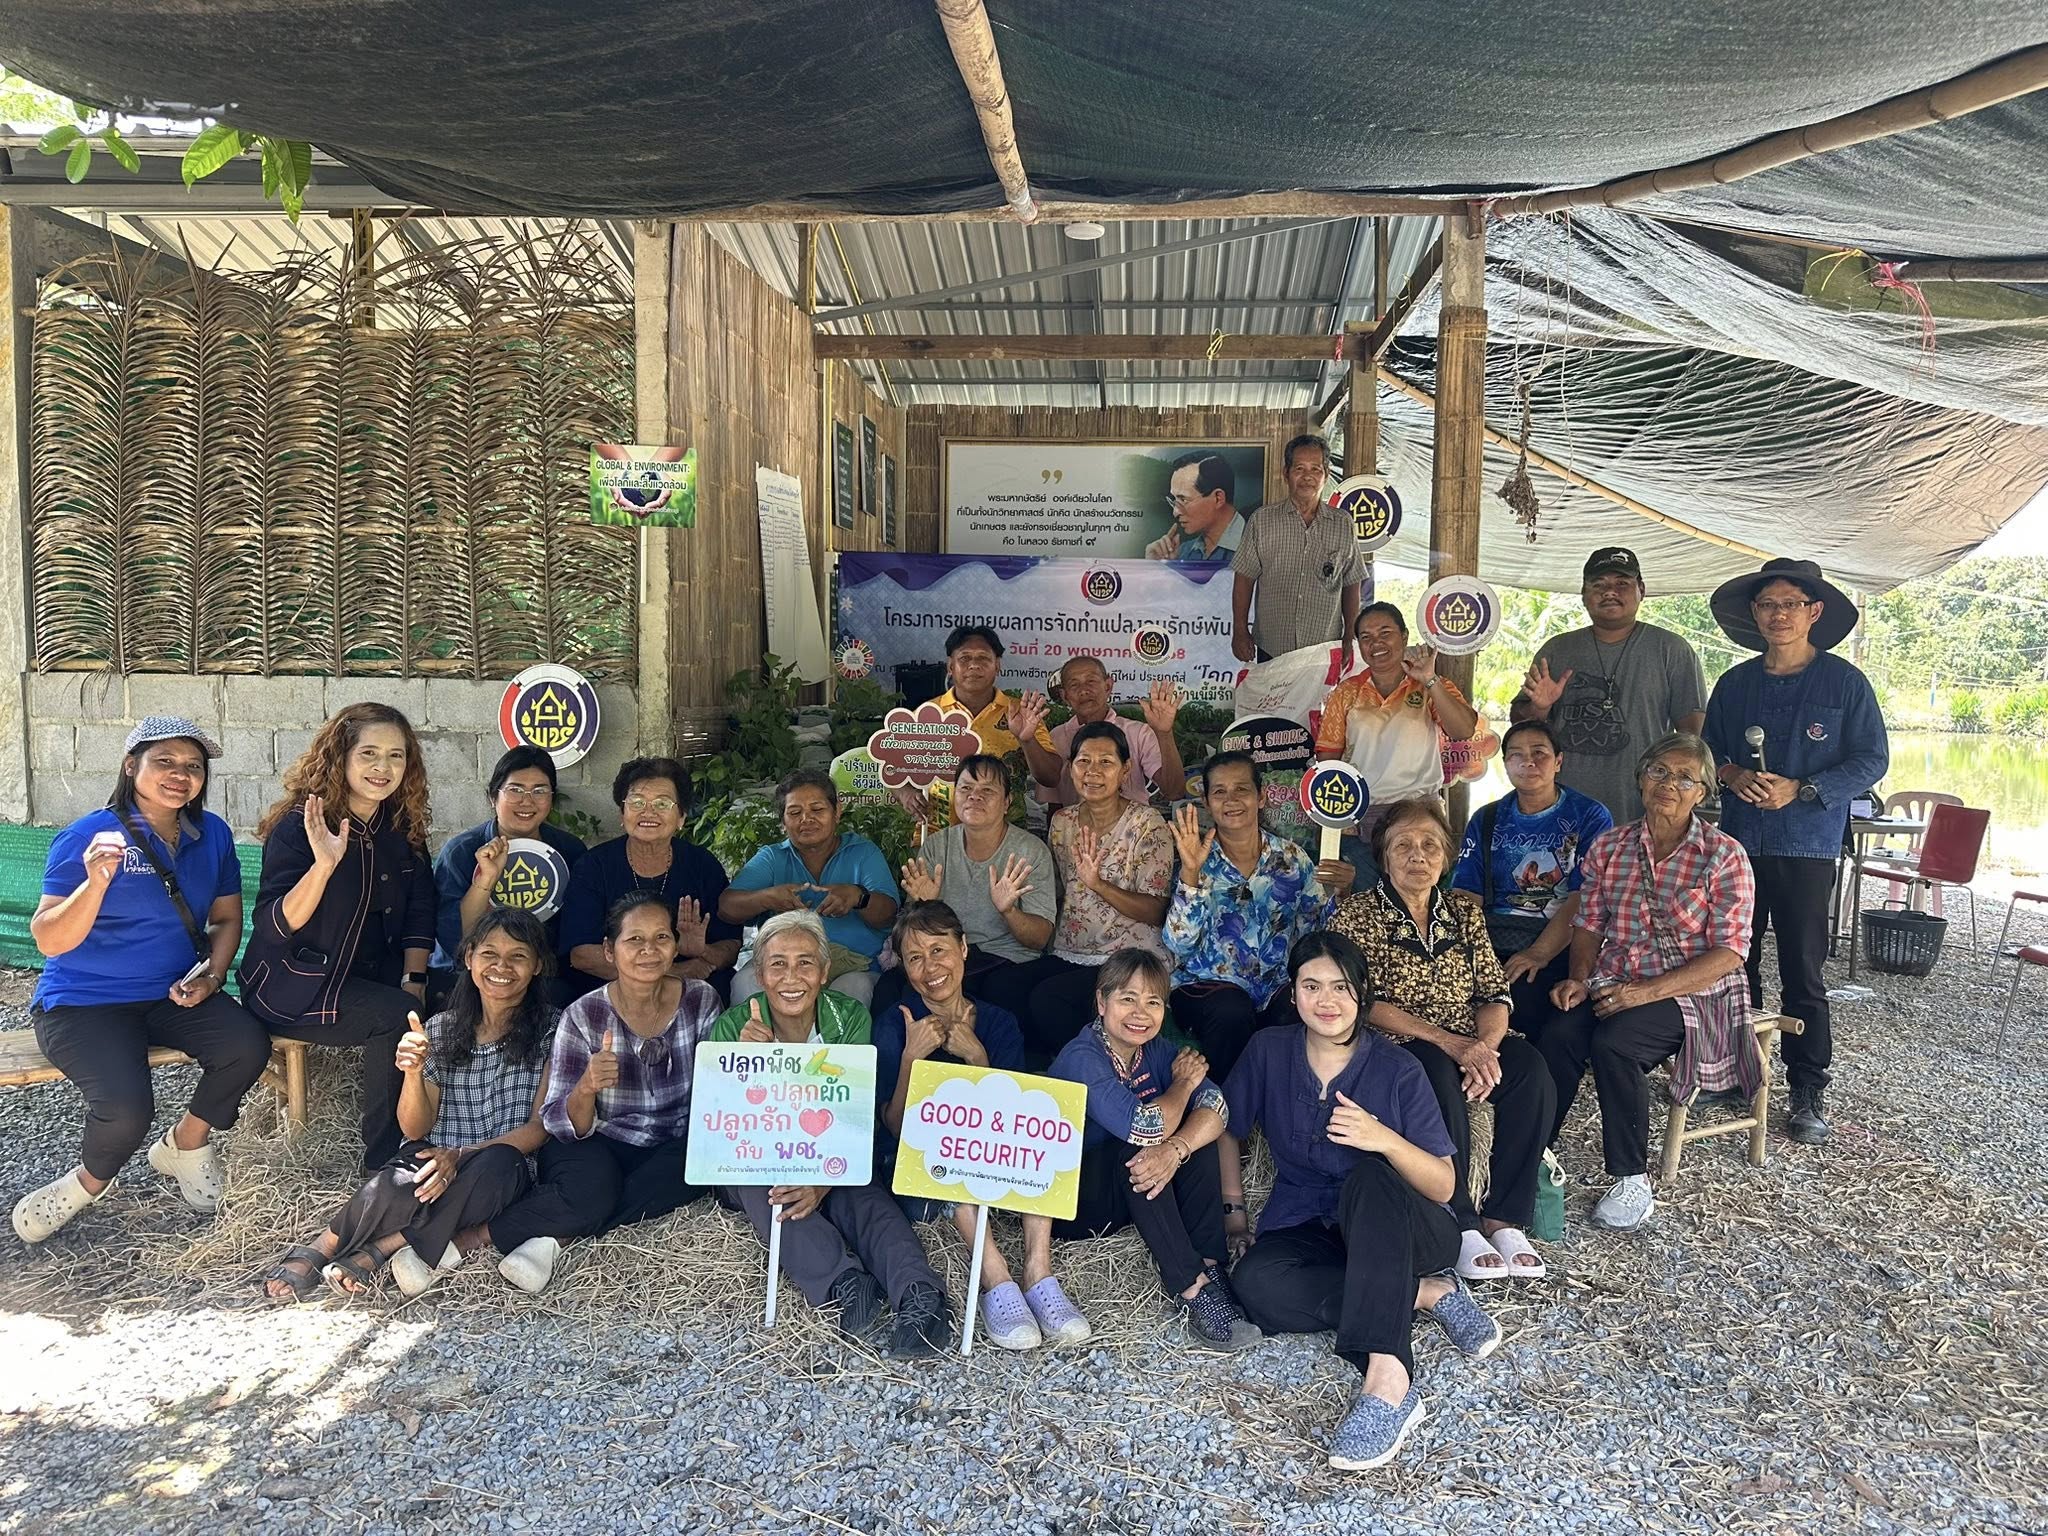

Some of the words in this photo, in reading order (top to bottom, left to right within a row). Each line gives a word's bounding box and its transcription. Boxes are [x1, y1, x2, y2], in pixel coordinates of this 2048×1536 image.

[596, 460, 625, 471] GLOBAL
[627, 461, 632, 471] &
[634, 462, 690, 473] ENVIRONMENT:
[987, 493, 1047, 503] พระมหากษัตริย์
[1053, 492, 1113, 503] องค์เดียวในโลก
[956, 505, 1045, 517] ที่เป็นทั้งนักวิทยาศาสตร์
[1047, 508, 1071, 518] นักคิด
[1073, 508, 1144, 518] นักสร้างนวัตกรรม
[969, 521, 1007, 531] นักเกษตร
[1114, 523, 1130, 532] ด้าน
[1002, 537, 1015, 546] คือ
[1018, 536, 1049, 546] ในหลวง
[1051, 536, 1083, 546] รัชกาลที่
[1085, 537, 1097, 546] ๙
[1009, 637, 1038, 656] วันที่
[1044, 645, 1062, 656] 20
[1067, 645, 1131, 658] พฤษภาค
[1563, 702, 1625, 723] USA
[890, 722, 960, 736] GENERATIONS
[1223, 735, 1251, 752] GIVE
[1253, 734, 1263, 748] &
[718, 1048, 802, 1083] ปลูกพืช
[770, 1076, 850, 1111] ปลูกผัก
[703, 1105, 791, 1141] ปลูกรัก
[920, 1101, 983, 1129] GOOD
[990, 1110, 1005, 1133] &
[1013, 1113, 1072, 1143] FOOD
[735, 1139, 763, 1160] กับ
[774, 1141, 823, 1160] พช.
[939, 1136, 1046, 1172] SECURITY
